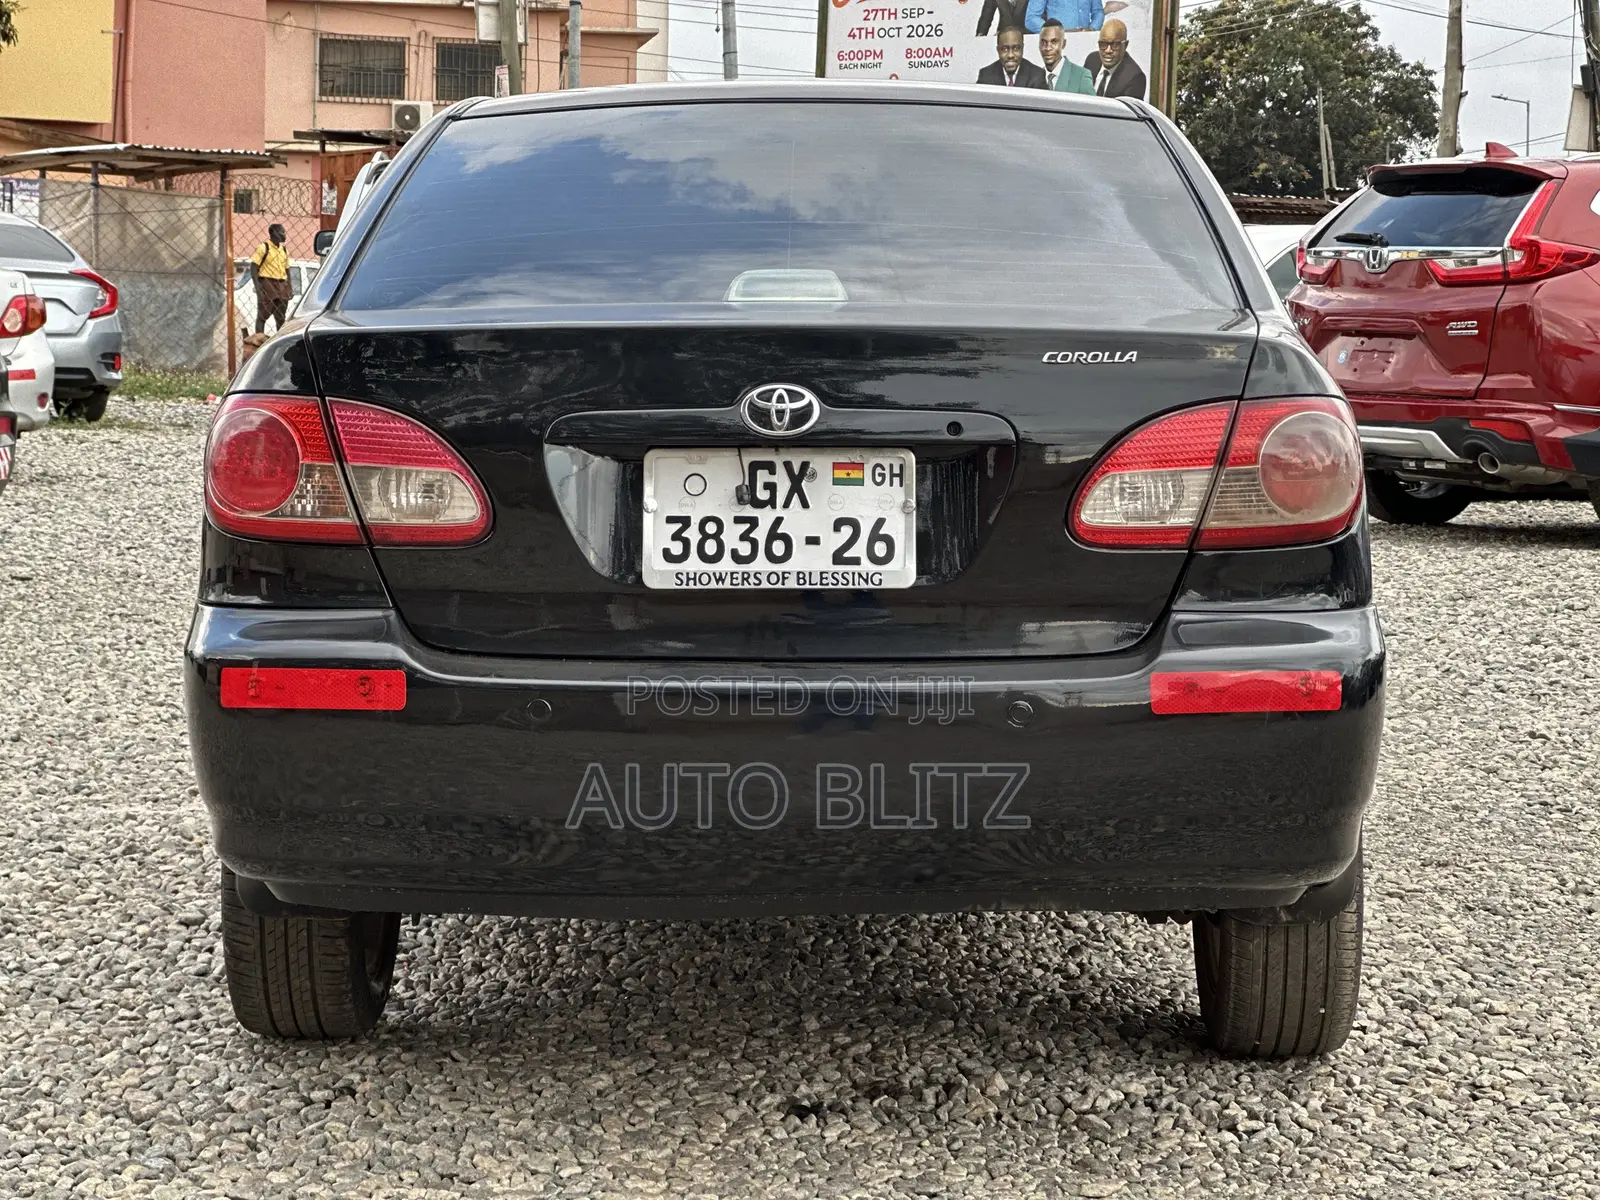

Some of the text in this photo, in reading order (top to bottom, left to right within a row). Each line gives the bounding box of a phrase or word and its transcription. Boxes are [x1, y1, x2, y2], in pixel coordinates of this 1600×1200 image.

[863, 8, 898, 21] 27TH
[847, 24, 944, 40] 4TH OCT 2026
[837, 49, 884, 61] 6:00PM
[905, 47, 954, 59] 8:00AM
[860, 62, 882, 70] NIGHT
[908, 60, 950, 69] SUNDAYS
[1041, 351, 1138, 364] COROLLA
[871, 463, 904, 488] GH
[748, 460, 811, 509] GX
[674, 572, 883, 586] SHOWERS OF BLESSING
